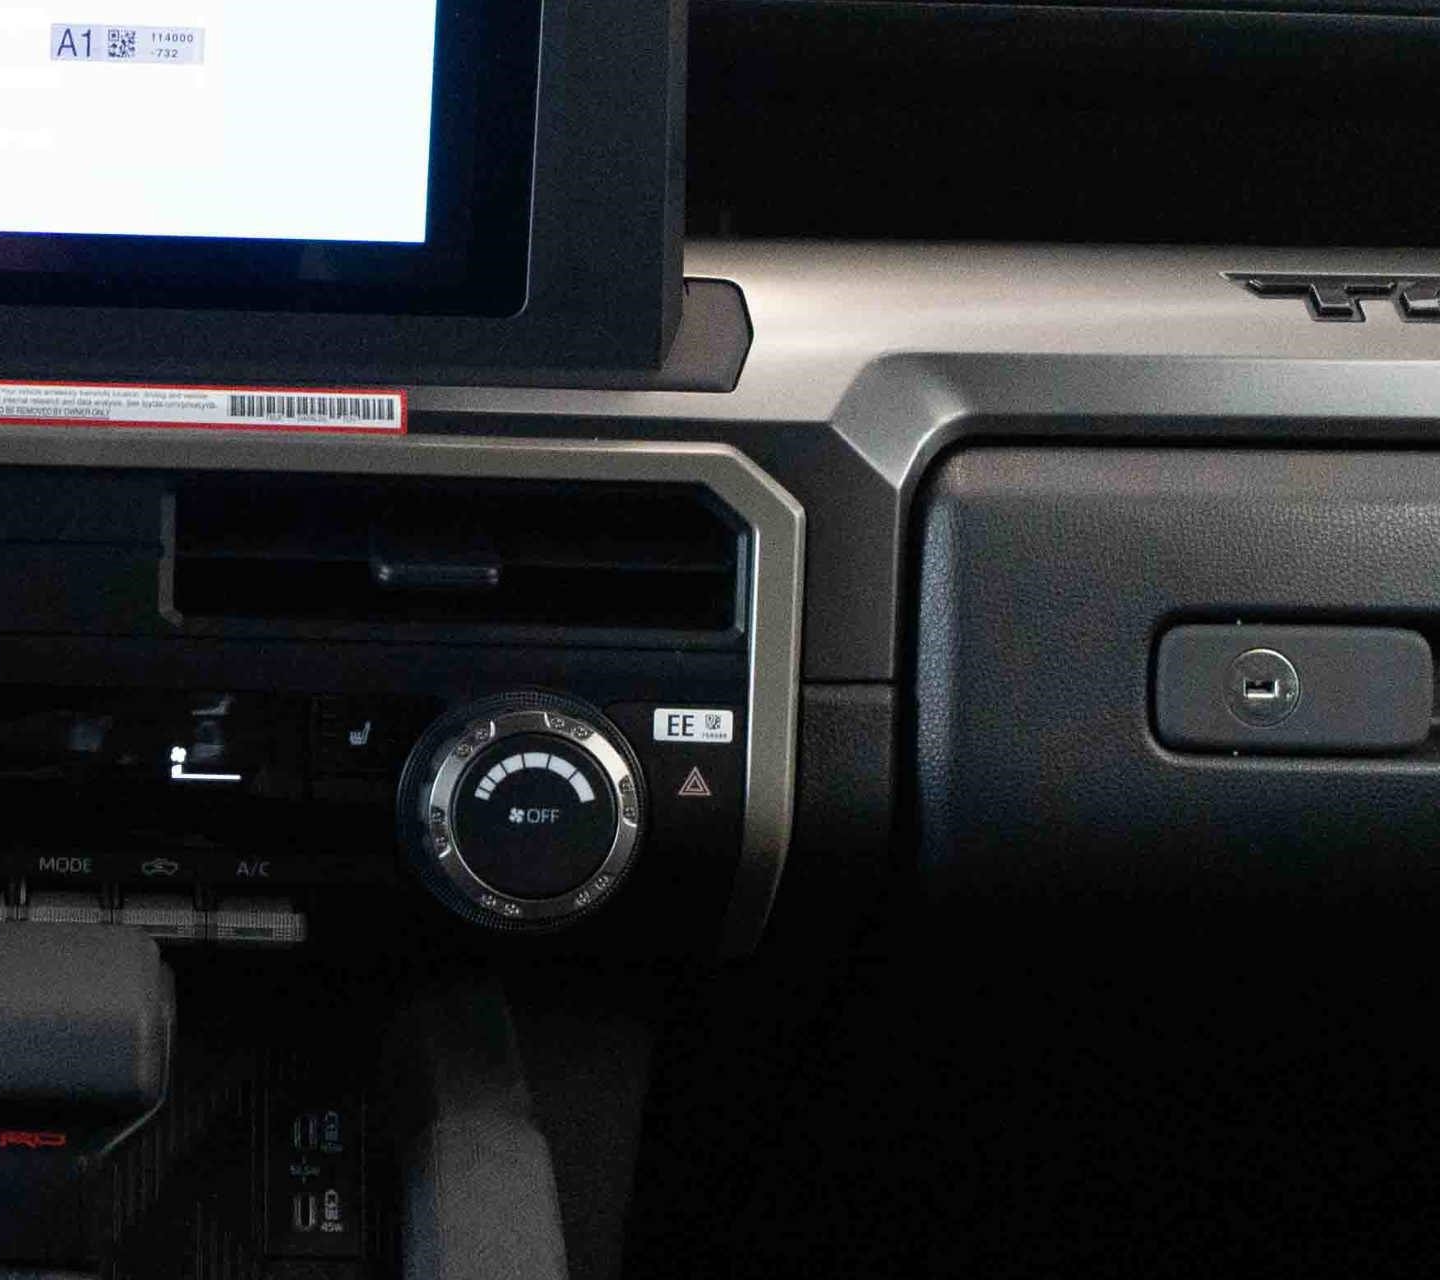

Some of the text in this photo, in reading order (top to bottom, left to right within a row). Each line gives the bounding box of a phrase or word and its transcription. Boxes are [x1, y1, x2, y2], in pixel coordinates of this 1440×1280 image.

[56, 27, 91, 58] A1
[667, 714, 695, 737] EE
[526, 808, 560, 824] OFF
[39, 856, 96, 874] MODE
[235, 860, 271, 879] A/C
